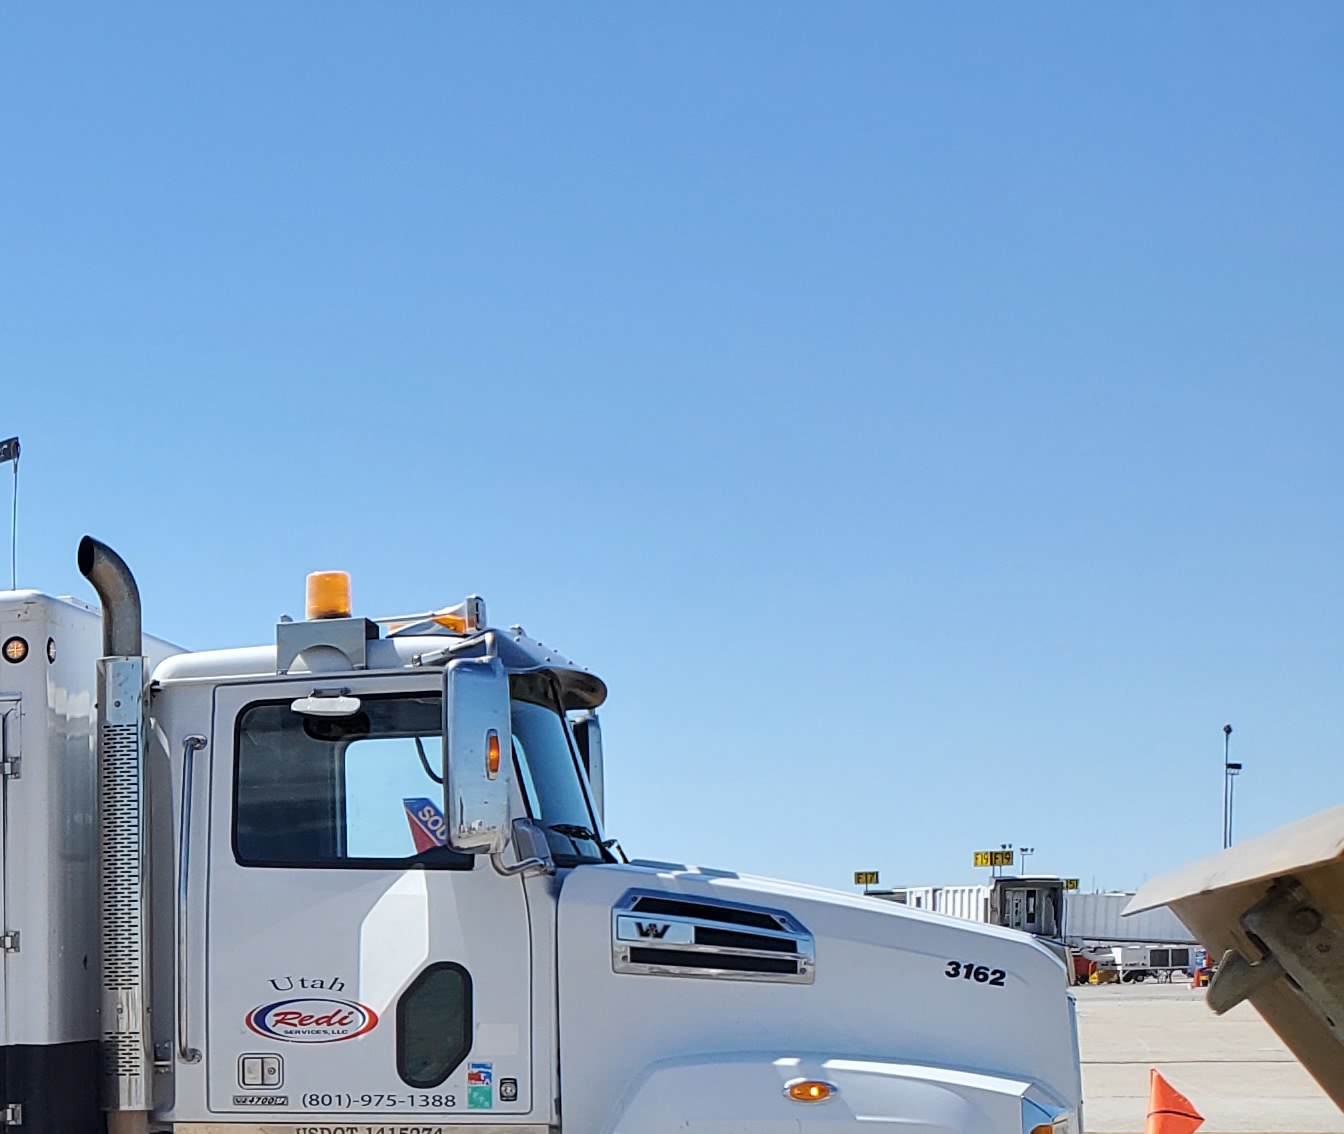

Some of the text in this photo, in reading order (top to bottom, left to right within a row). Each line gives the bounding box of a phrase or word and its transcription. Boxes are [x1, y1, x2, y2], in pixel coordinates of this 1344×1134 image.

[944, 960, 1007, 987] 3162
[267, 976, 346, 992] Utah
[272, 1008, 354, 1028] Redi
[302, 1093, 456, 1108] (801)-975-1388
